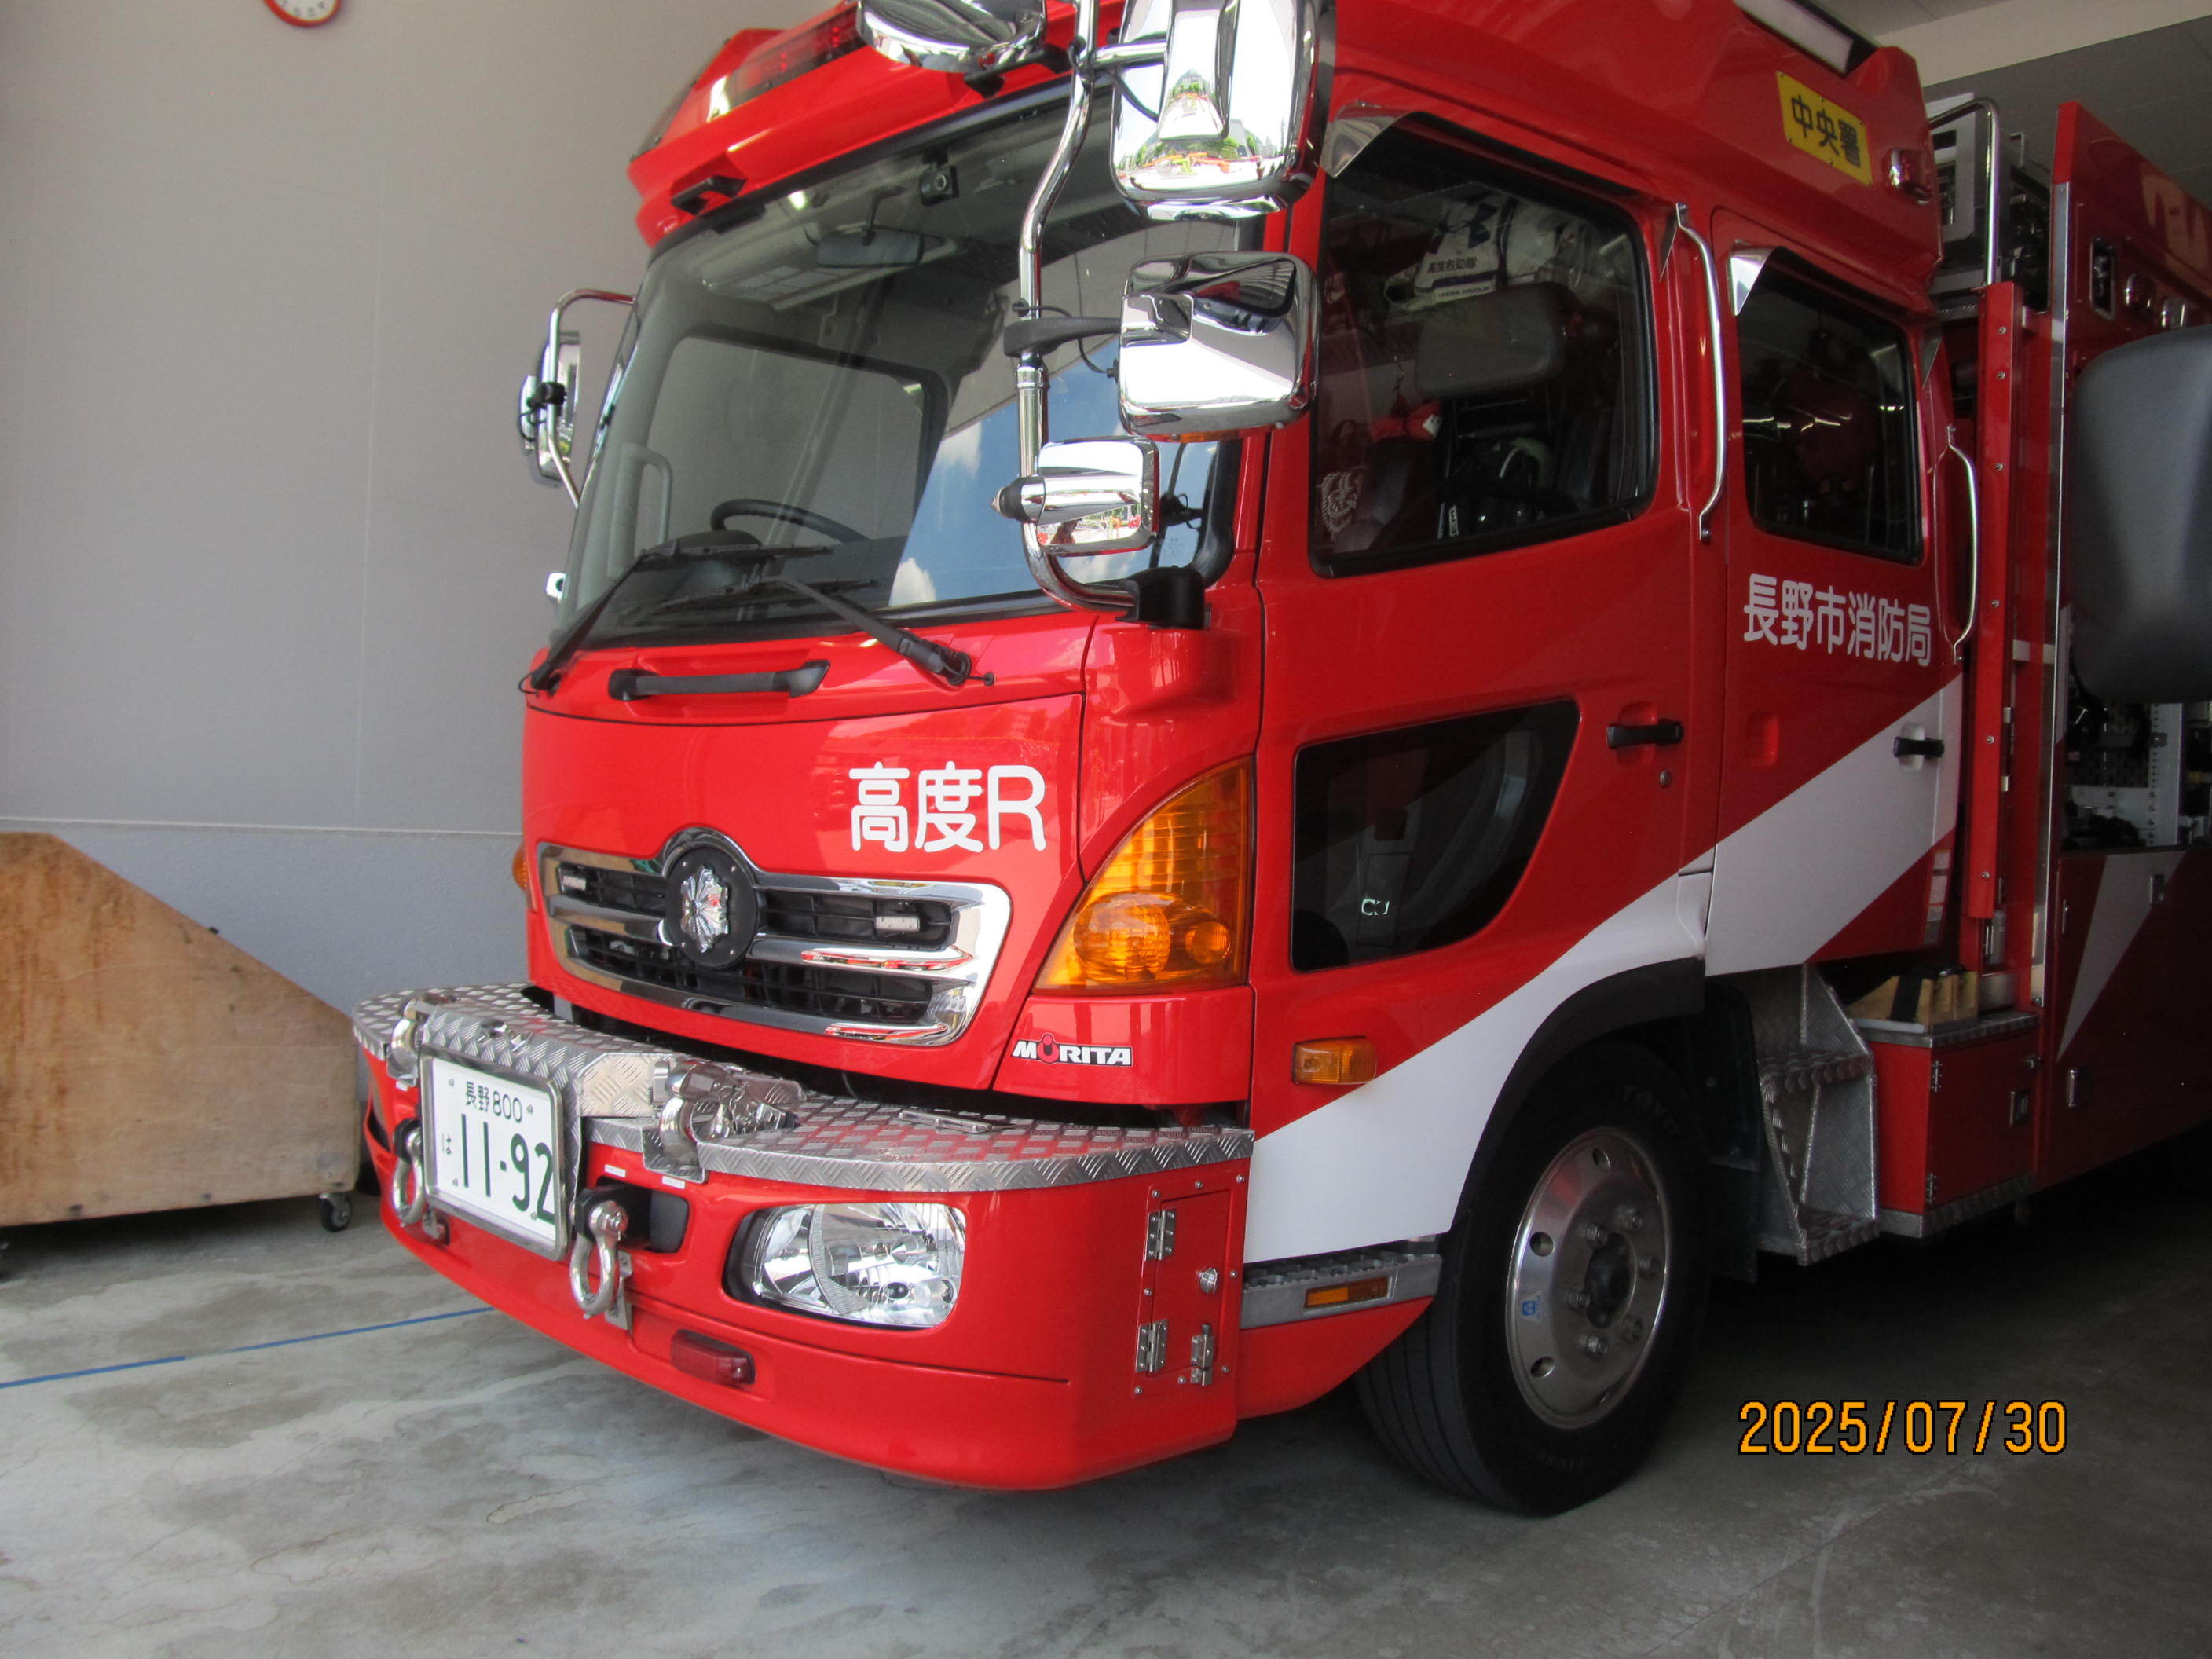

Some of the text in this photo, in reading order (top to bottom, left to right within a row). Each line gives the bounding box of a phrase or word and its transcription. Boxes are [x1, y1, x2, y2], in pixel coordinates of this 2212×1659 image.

[1791, 93, 1861, 169] 中央署
[1743, 573, 1932, 667] 長野市消防局
[848, 760, 1046, 853] 高度R
[1013, 1034, 1132, 1066] MORITA
[465, 1081, 522, 1123] 長野800
